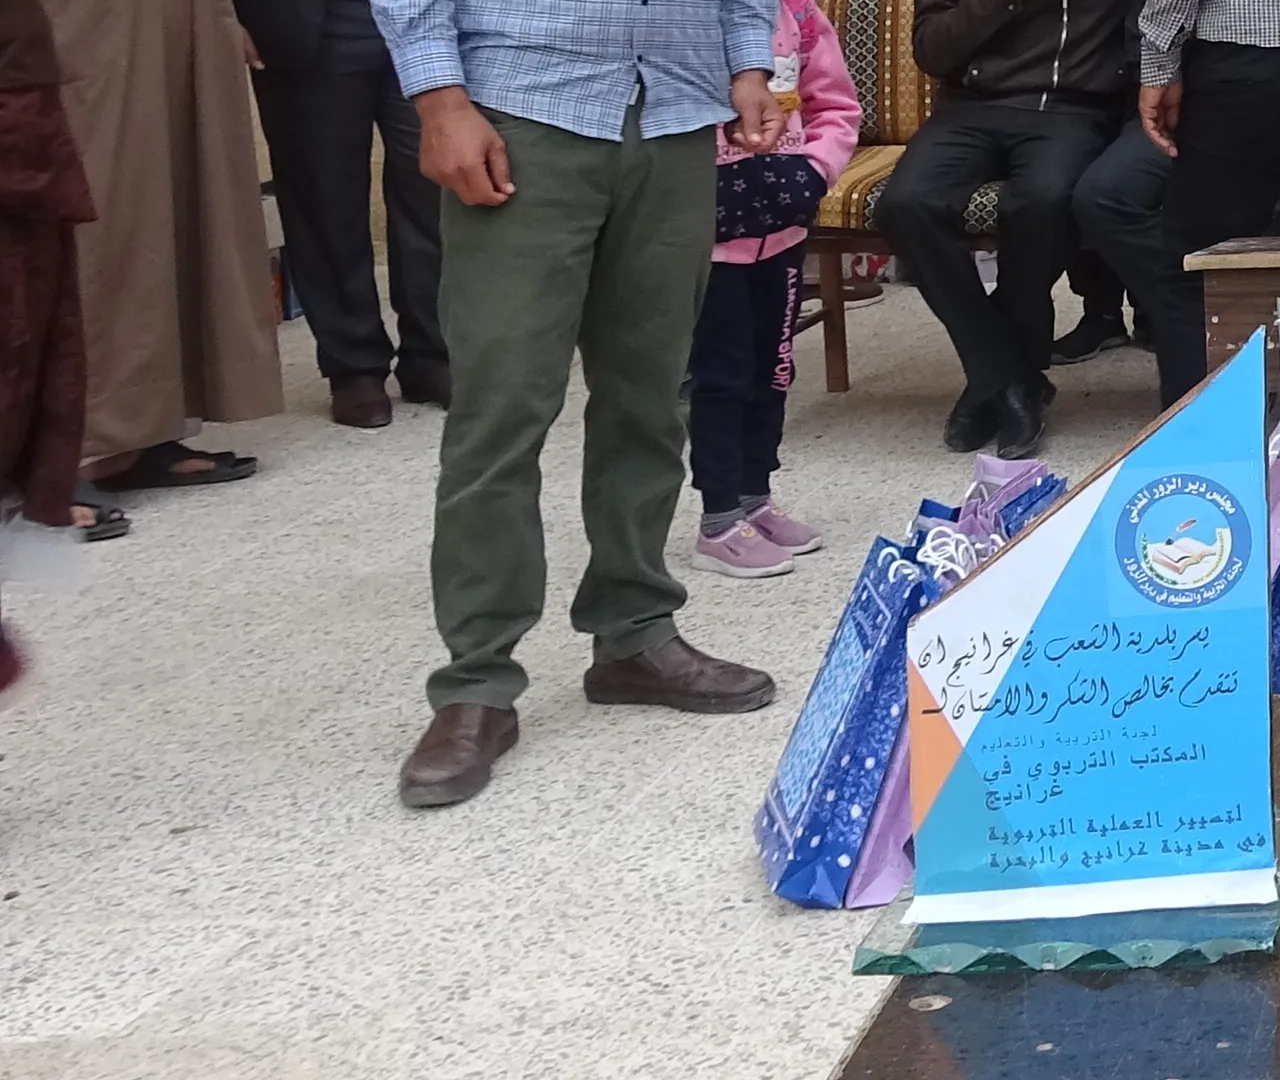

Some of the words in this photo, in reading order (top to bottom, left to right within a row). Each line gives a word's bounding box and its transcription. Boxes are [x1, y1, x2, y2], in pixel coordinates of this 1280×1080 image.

[1153, 477, 1182, 499] الزور
[1184, 481, 1207, 493] دير
[1125, 487, 1152, 524] المدني
[1205, 490, 1236, 515] مجلس
[1124, 557, 1147, 584] الزور
[1226, 557, 1243, 583] لجنة
[1140, 579, 1157, 598] دير
[1156, 589, 1168, 603] في
[1168, 591, 1202, 604] والتعليم
[1203, 579, 1227, 600] التربية
[1022, 630, 1038, 668] في
[1044, 621, 1121, 668] الشعب
[1127, 623, 1177, 655] بلدية
[1168, 626, 1210, 661] يسر
[946, 630, 1020, 687] غرانيج
[1045, 669, 1110, 724] الشكر
[1112, 676, 1174, 718] بخالص
[1179, 668, 1239, 708] تتقدم
[1055, 729, 1112, 747] التربية
[1122, 724, 1157, 740] لجنة
[984, 754, 1012, 784] في
[1027, 750, 1116, 782] التربوي
[1130, 743, 1207, 770] المكتب
[984, 782, 1064, 811] غرانيج
[987, 818, 1077, 846] التربوية
[1087, 810, 1163, 837] العملية
[1161, 838, 1226, 857] مدينة
